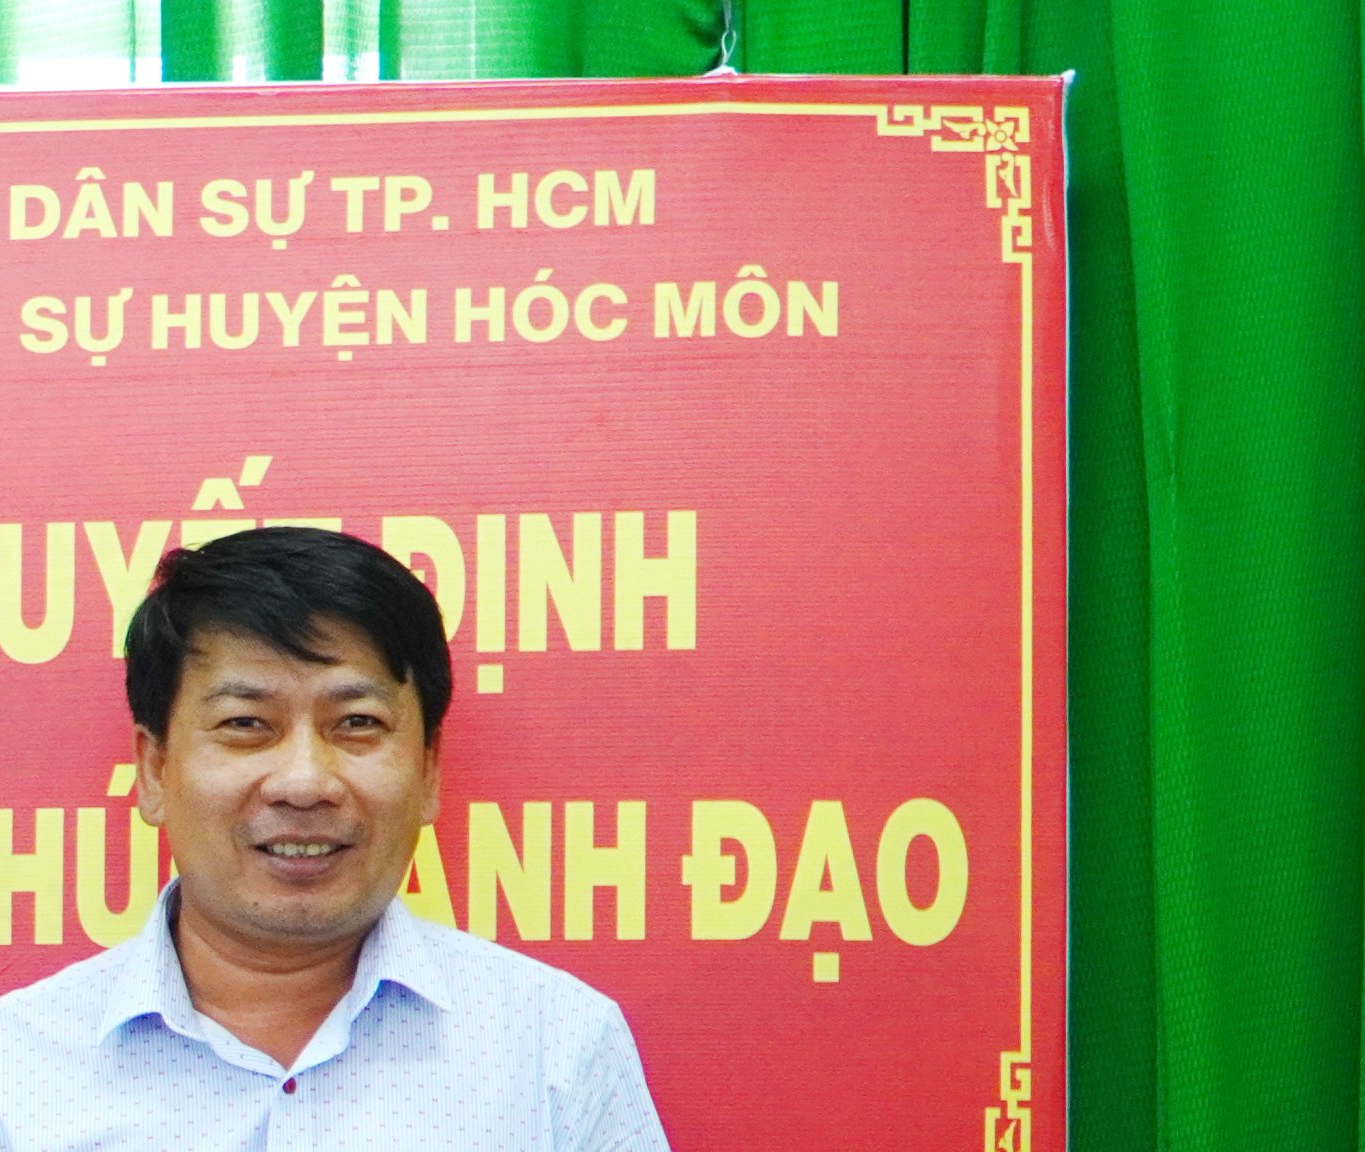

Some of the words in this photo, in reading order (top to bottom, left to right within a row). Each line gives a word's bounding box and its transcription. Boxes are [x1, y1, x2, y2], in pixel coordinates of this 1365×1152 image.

[10, 167, 173, 239] DÂN
[201, 171, 314, 249] SỰ
[331, 176, 449, 231] TP.
[478, 169, 655, 228] HCM
[22, 288, 132, 365] SỰ
[151, 274, 426, 359] HUYỆN
[455, 268, 627, 342] HÓC
[654, 265, 838, 337] MÔN
[683, 799, 968, 981] ĐẠO
